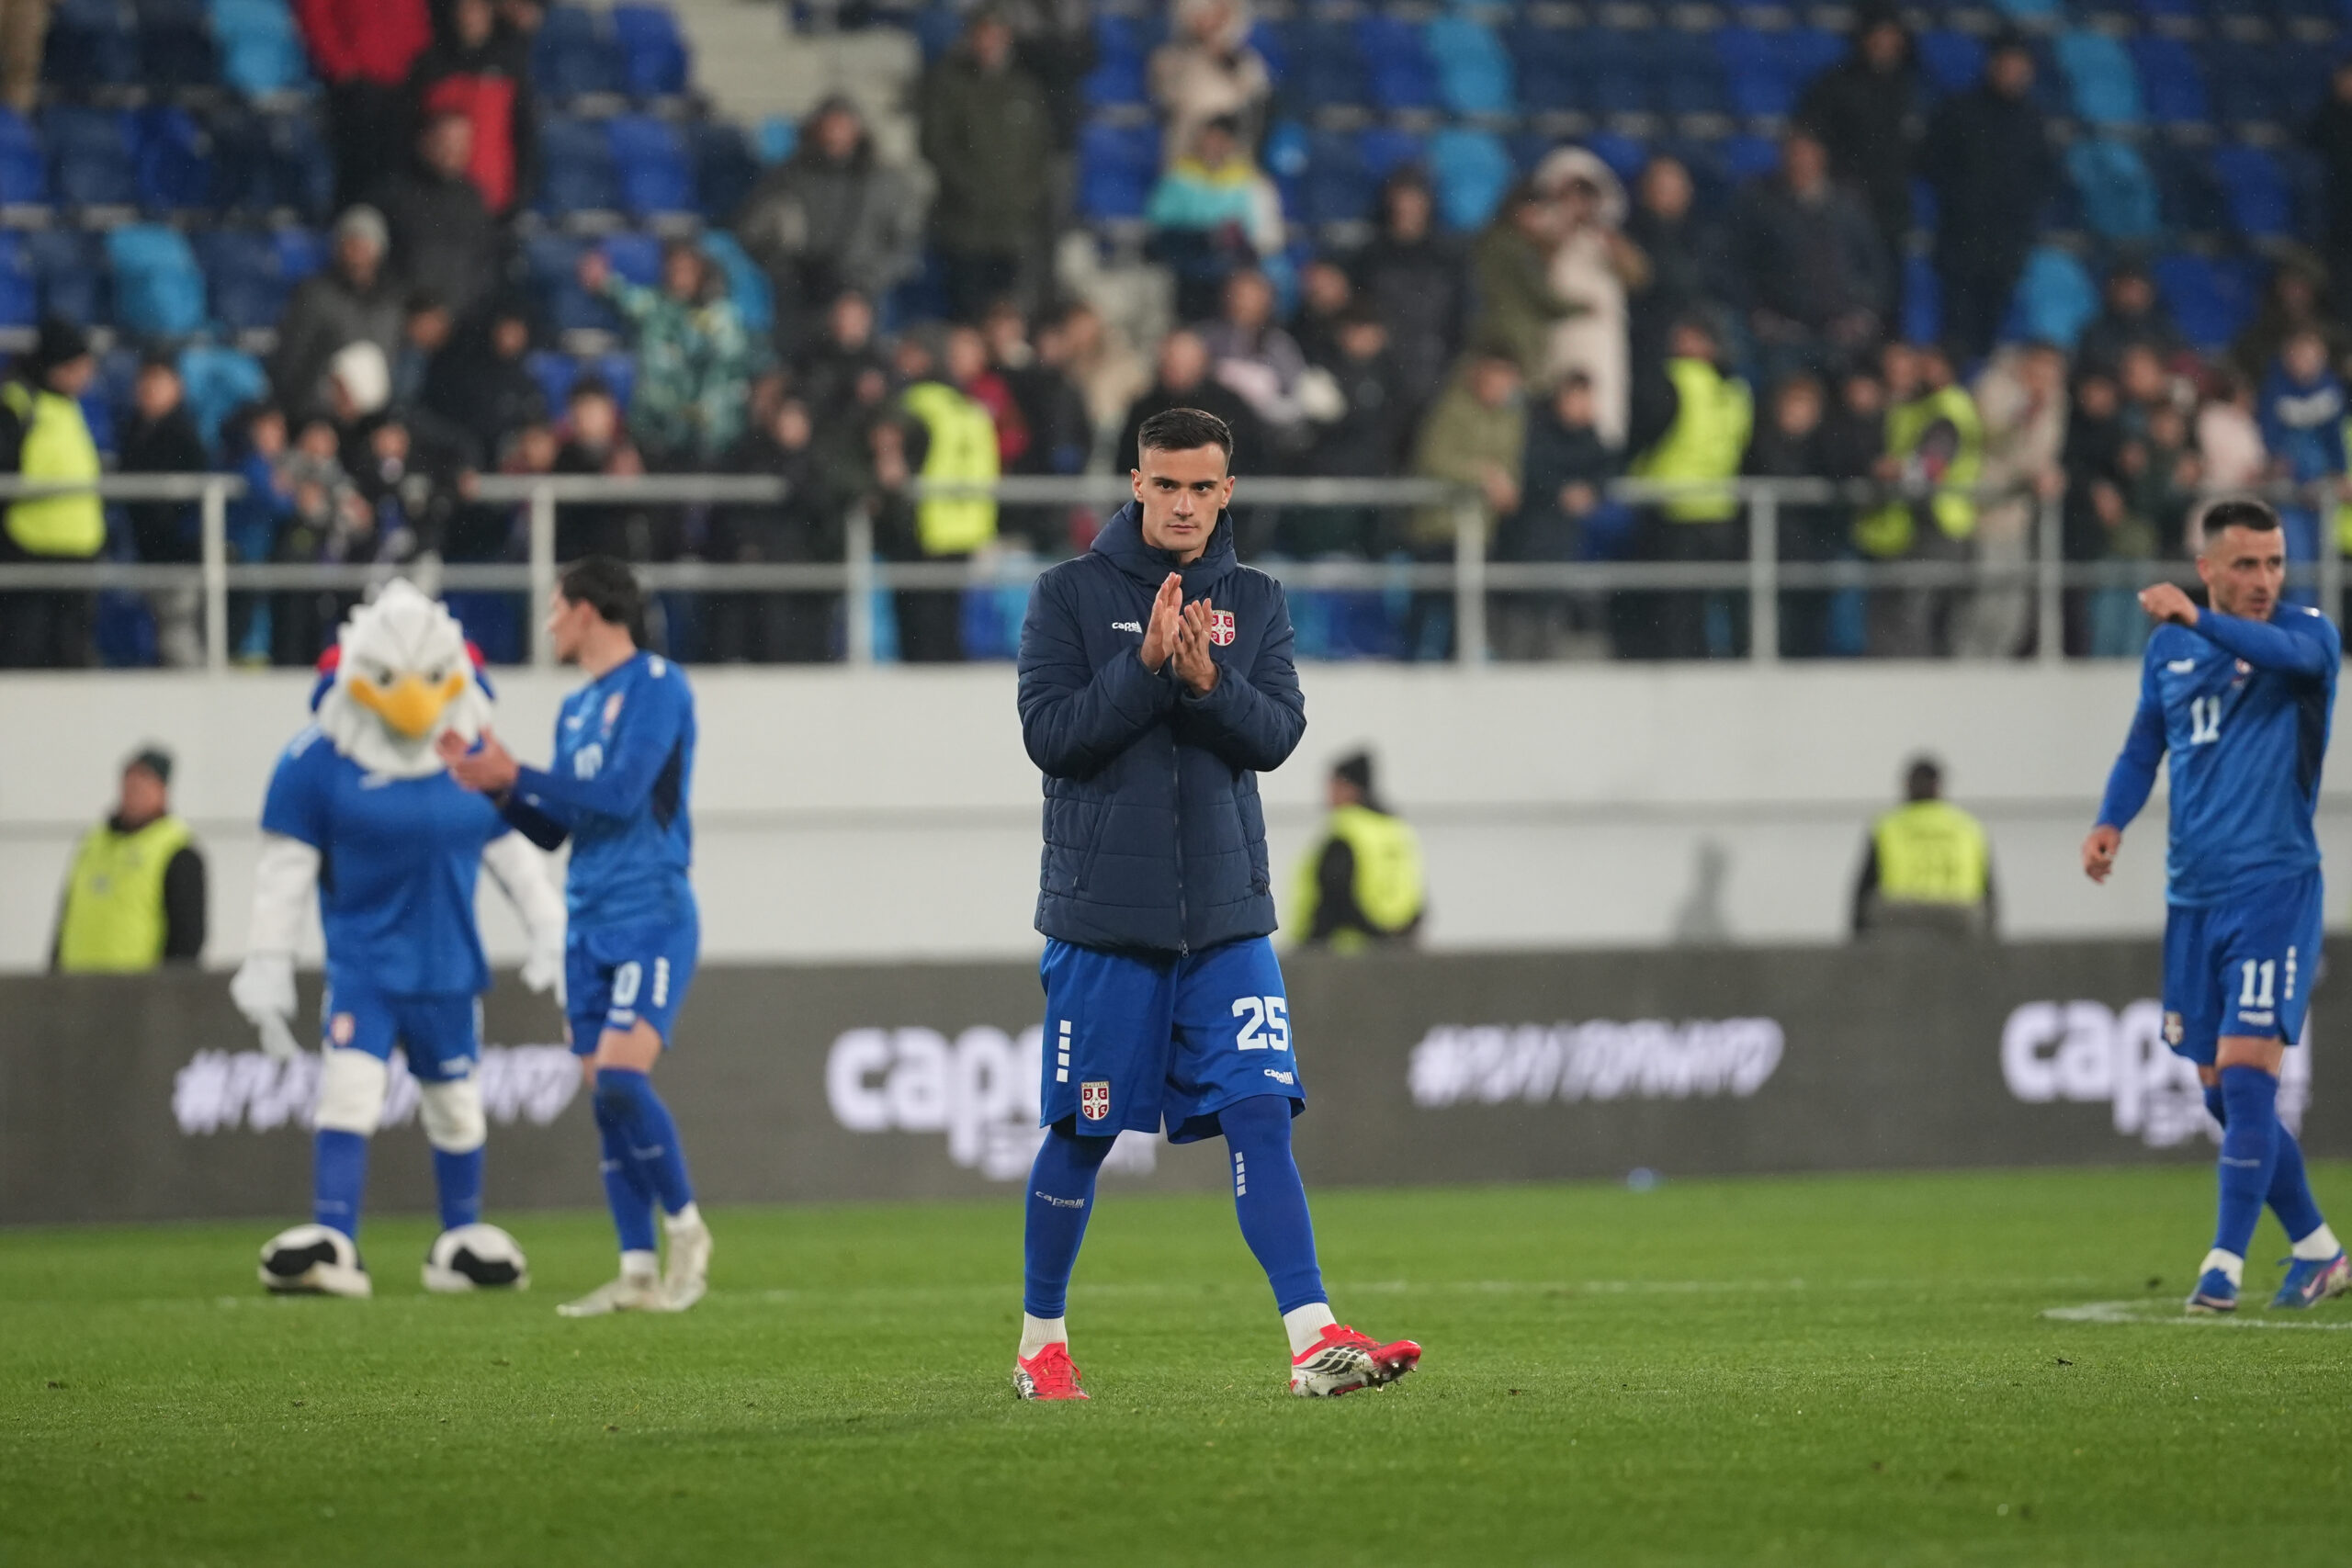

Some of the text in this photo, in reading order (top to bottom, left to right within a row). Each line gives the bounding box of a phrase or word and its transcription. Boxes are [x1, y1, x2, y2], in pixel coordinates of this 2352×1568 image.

[2190, 695, 2221, 745] 11
[2239, 958, 2276, 1009] 11
[1231, 996, 1289, 1052] 25
